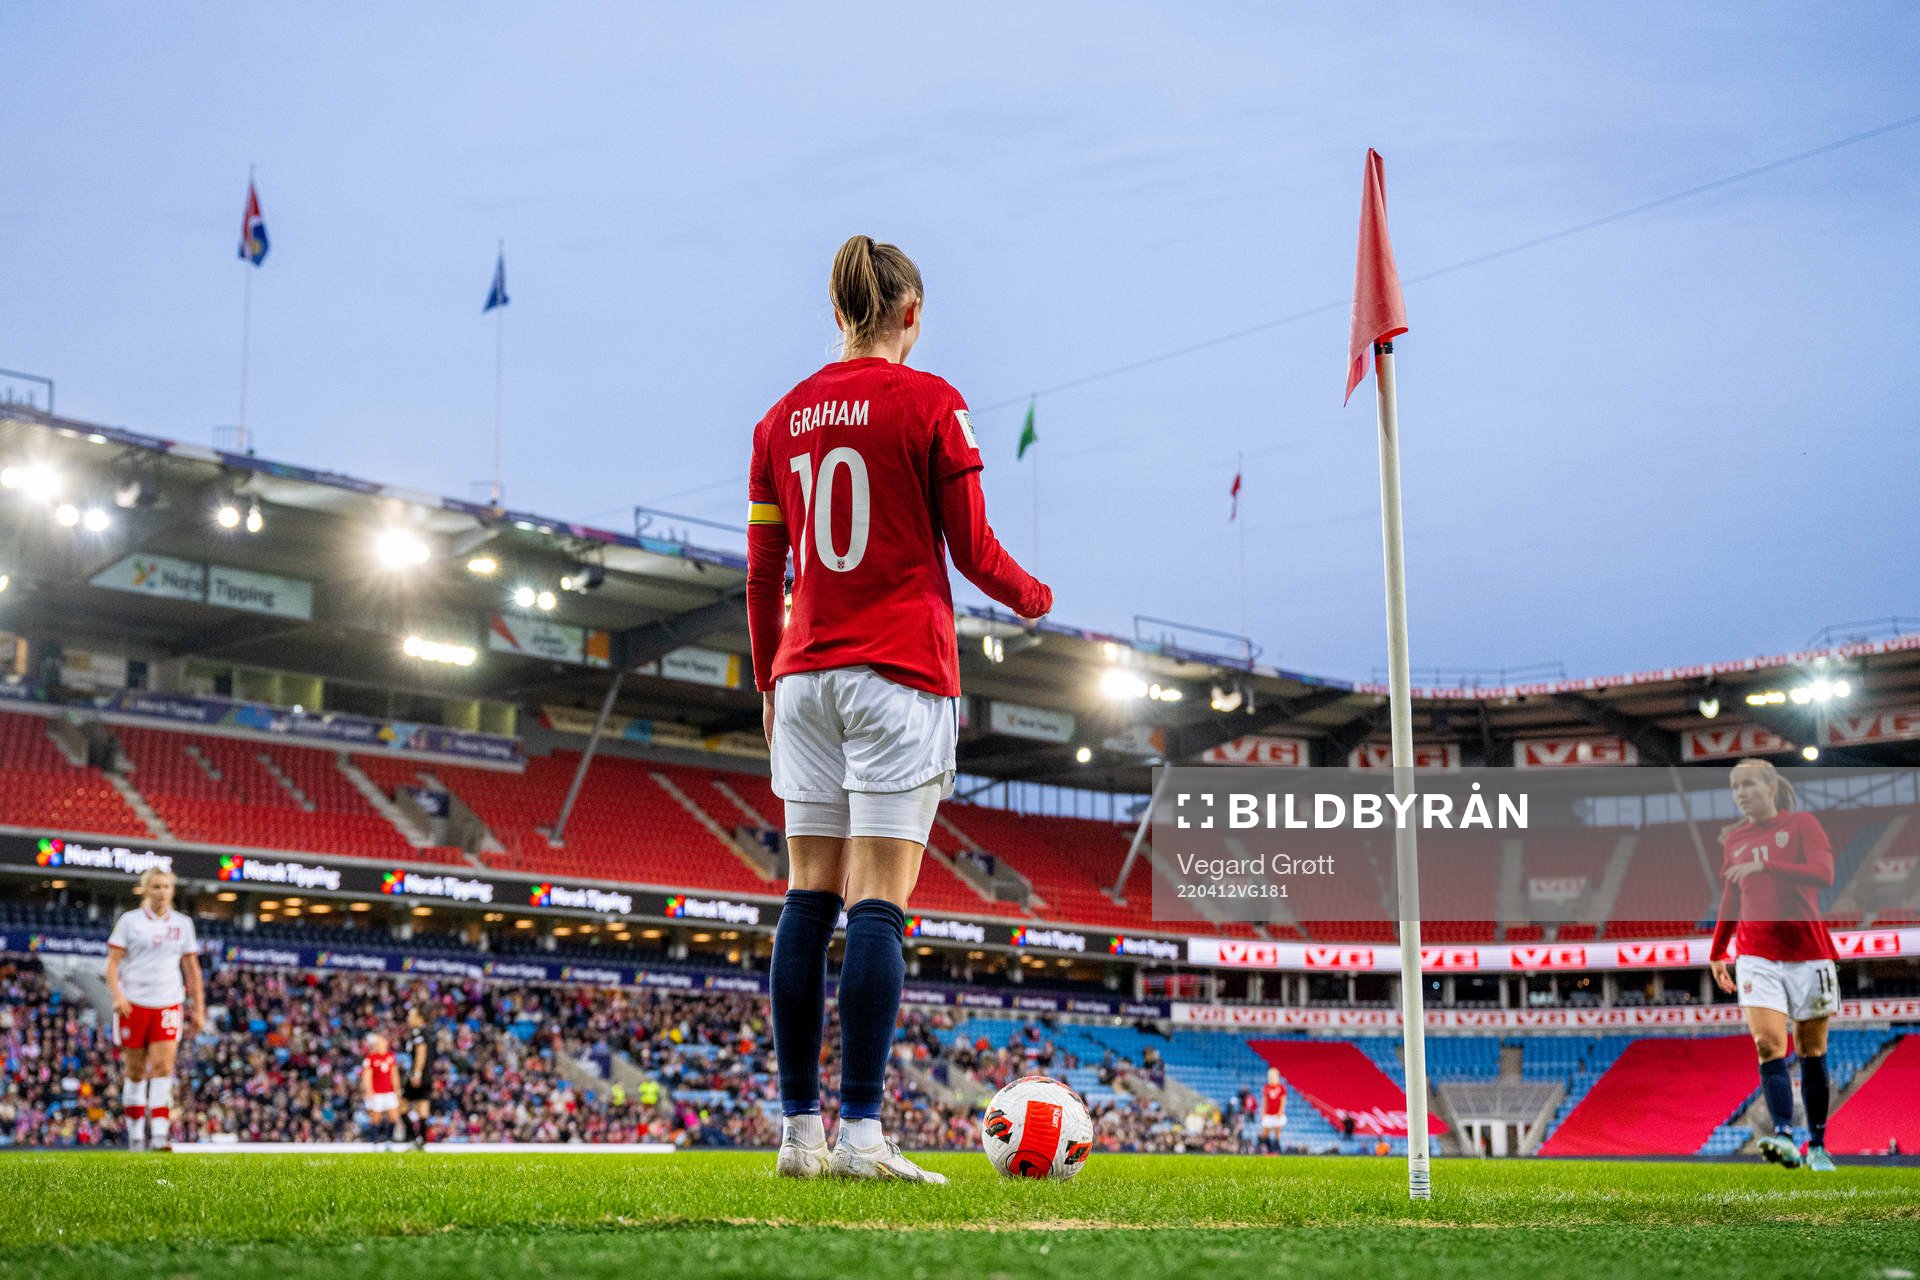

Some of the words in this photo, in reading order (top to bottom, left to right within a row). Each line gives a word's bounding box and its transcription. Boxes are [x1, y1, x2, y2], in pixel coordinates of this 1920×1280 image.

[789, 400, 870, 437] GRAHAM
[789, 446, 871, 577] 10
[1214, 736, 1299, 765] VG
[1526, 741, 1623, 765] VG
[1752, 845, 1769, 863] 11
[1219, 943, 1277, 966] VG
[1306, 946, 1374, 969] VG
[1421, 948, 1478, 971] VG
[1511, 947, 1586, 969] VG
[1617, 943, 1689, 967] VG
[1816, 968, 1832, 995] 11
